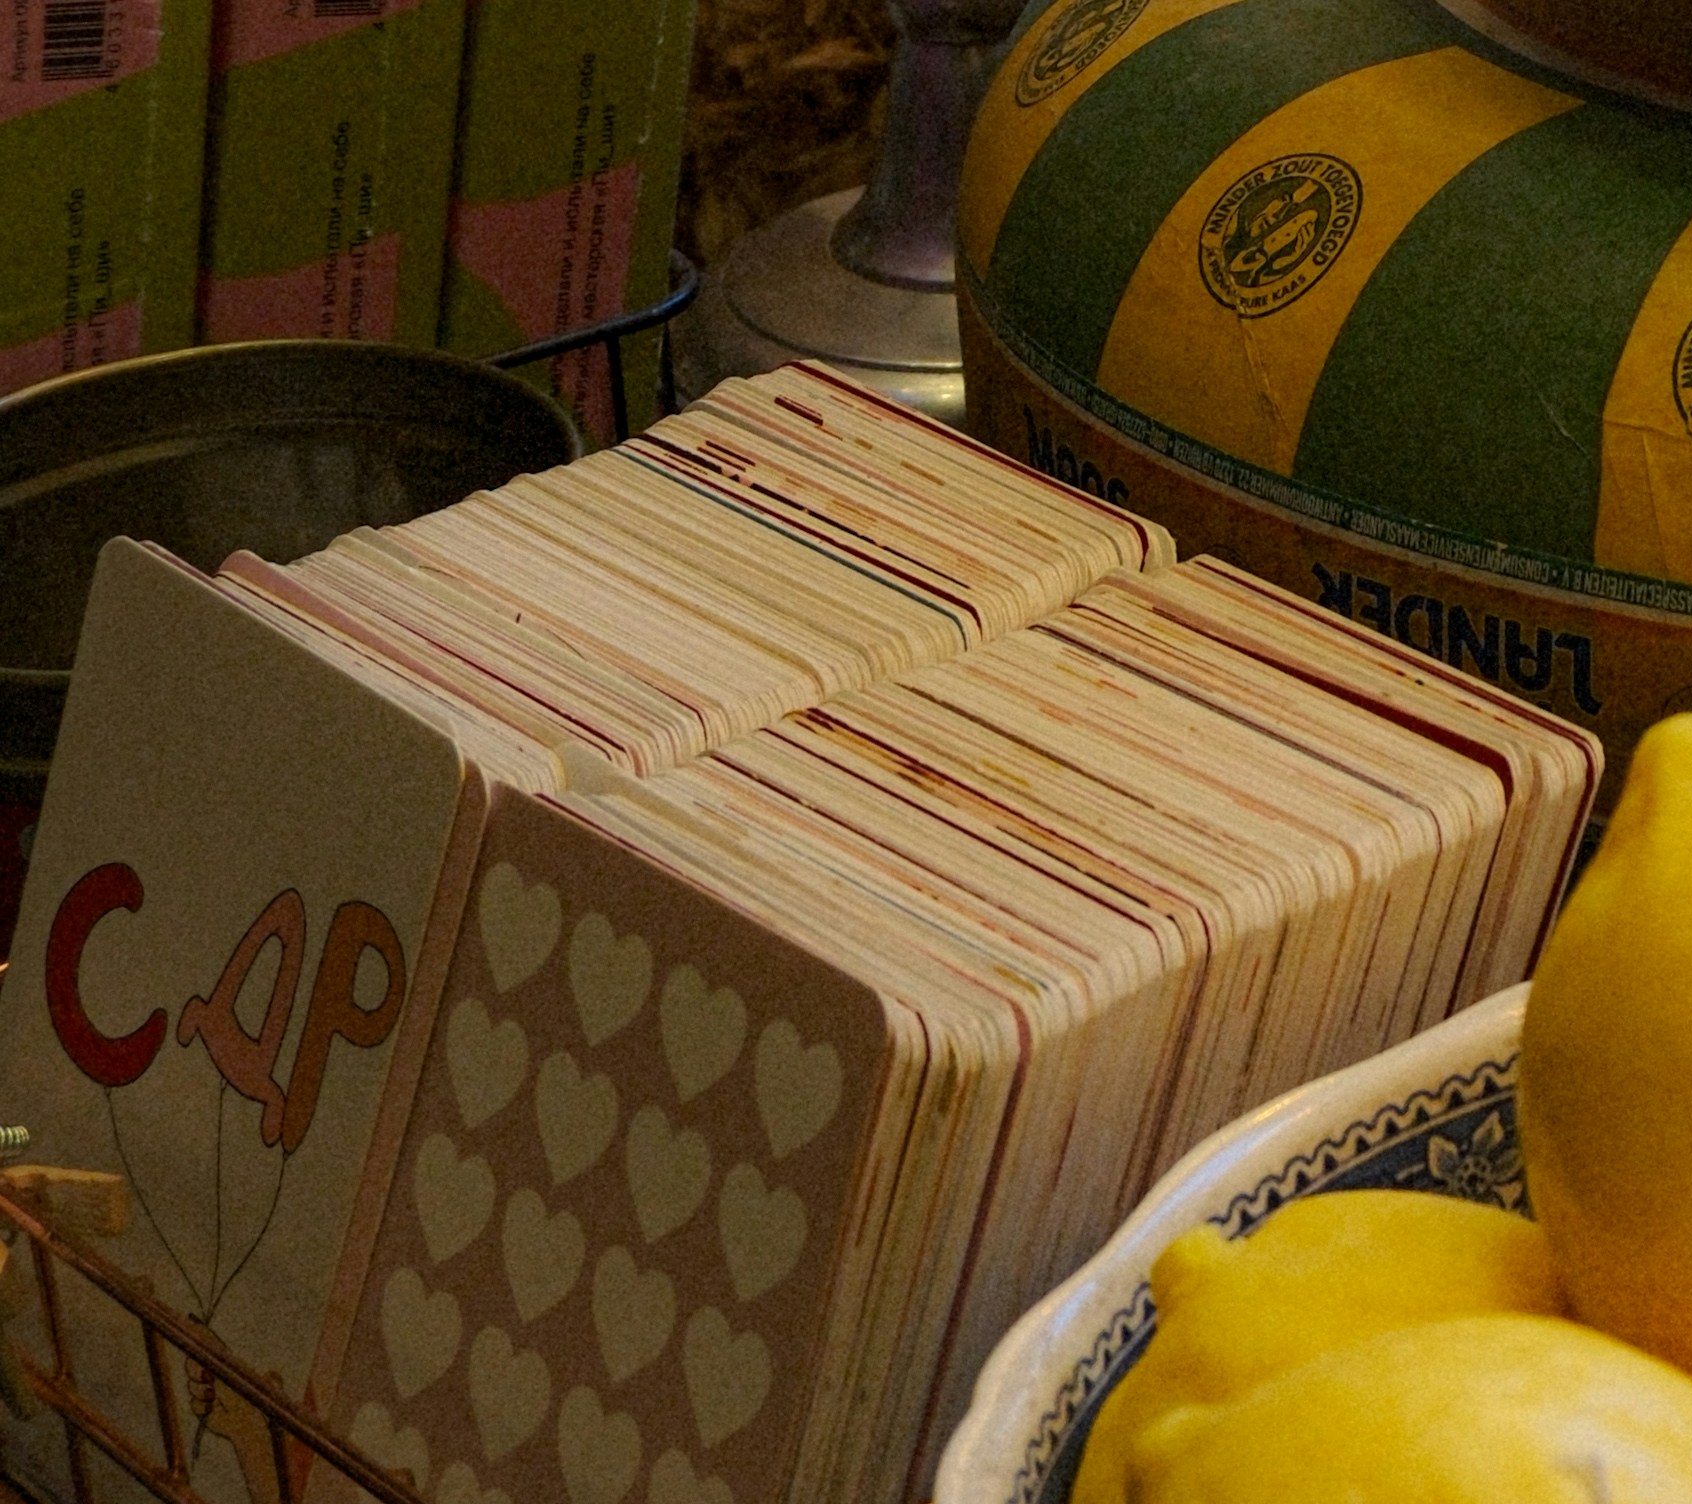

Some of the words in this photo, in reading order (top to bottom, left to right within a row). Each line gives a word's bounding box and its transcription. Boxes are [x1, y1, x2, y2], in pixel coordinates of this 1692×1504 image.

[1207, 171, 1266, 234] MINDER
[1270, 158, 1323, 180] ZOUT
[1311, 161, 1354, 266] TOEGEVOEGD
[1272, 273, 1307, 301] KAAS
[1312, 562, 1604, 715] LANDER
